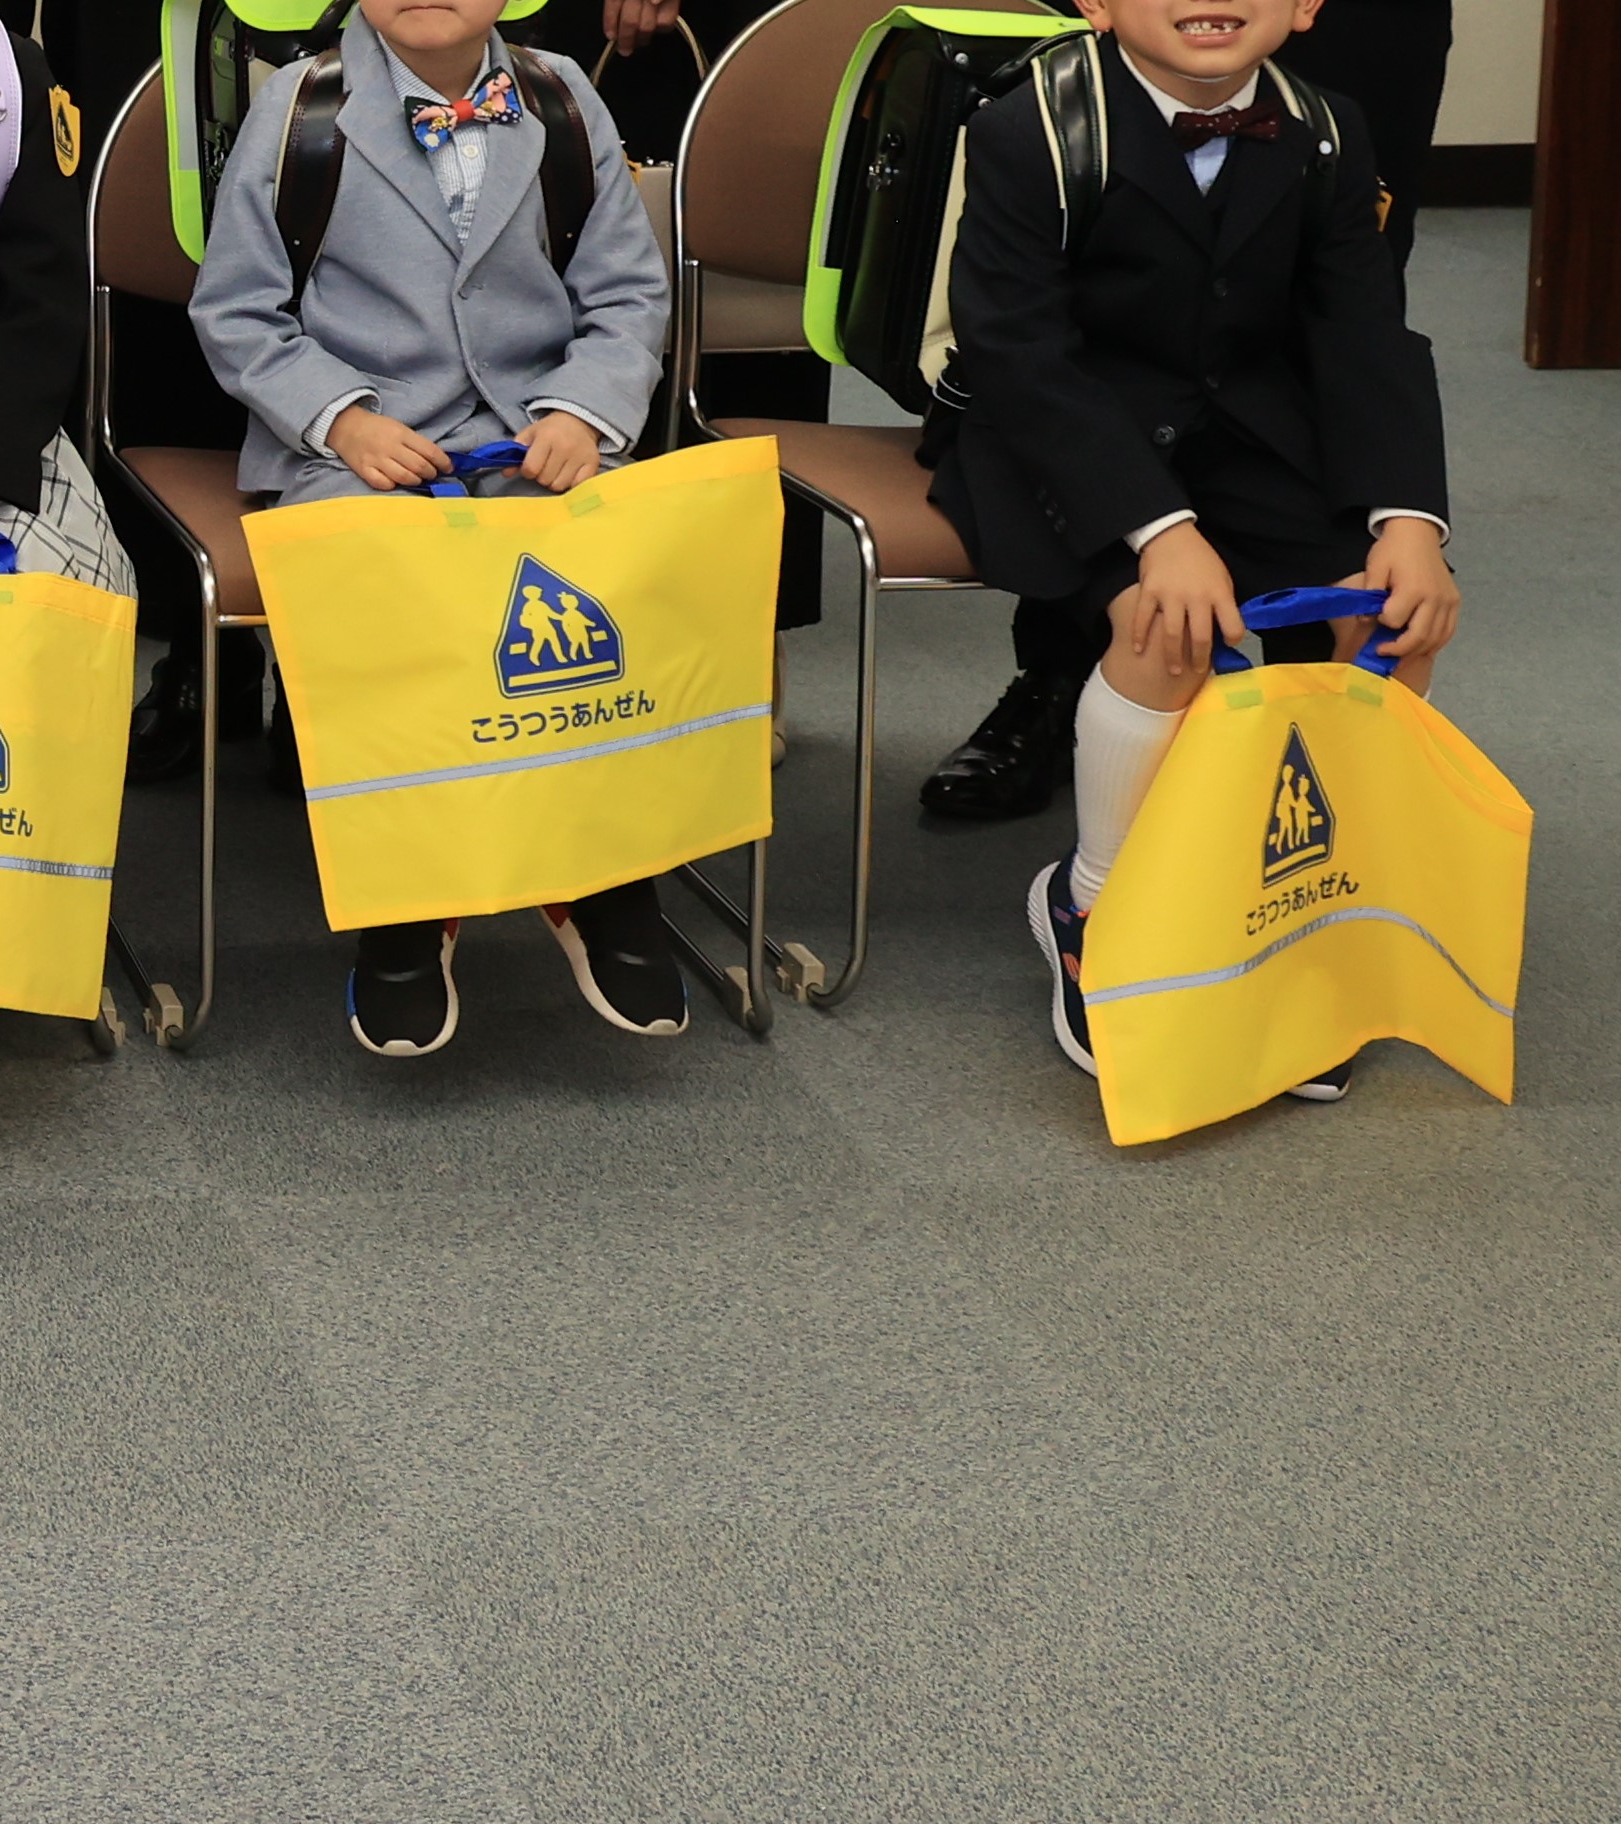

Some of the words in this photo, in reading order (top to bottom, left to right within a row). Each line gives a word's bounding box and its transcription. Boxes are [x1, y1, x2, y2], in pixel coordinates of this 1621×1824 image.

[471, 690, 656, 743] こうつうあんぜん
[1246, 872, 1360, 936] こうつうあんぜん
